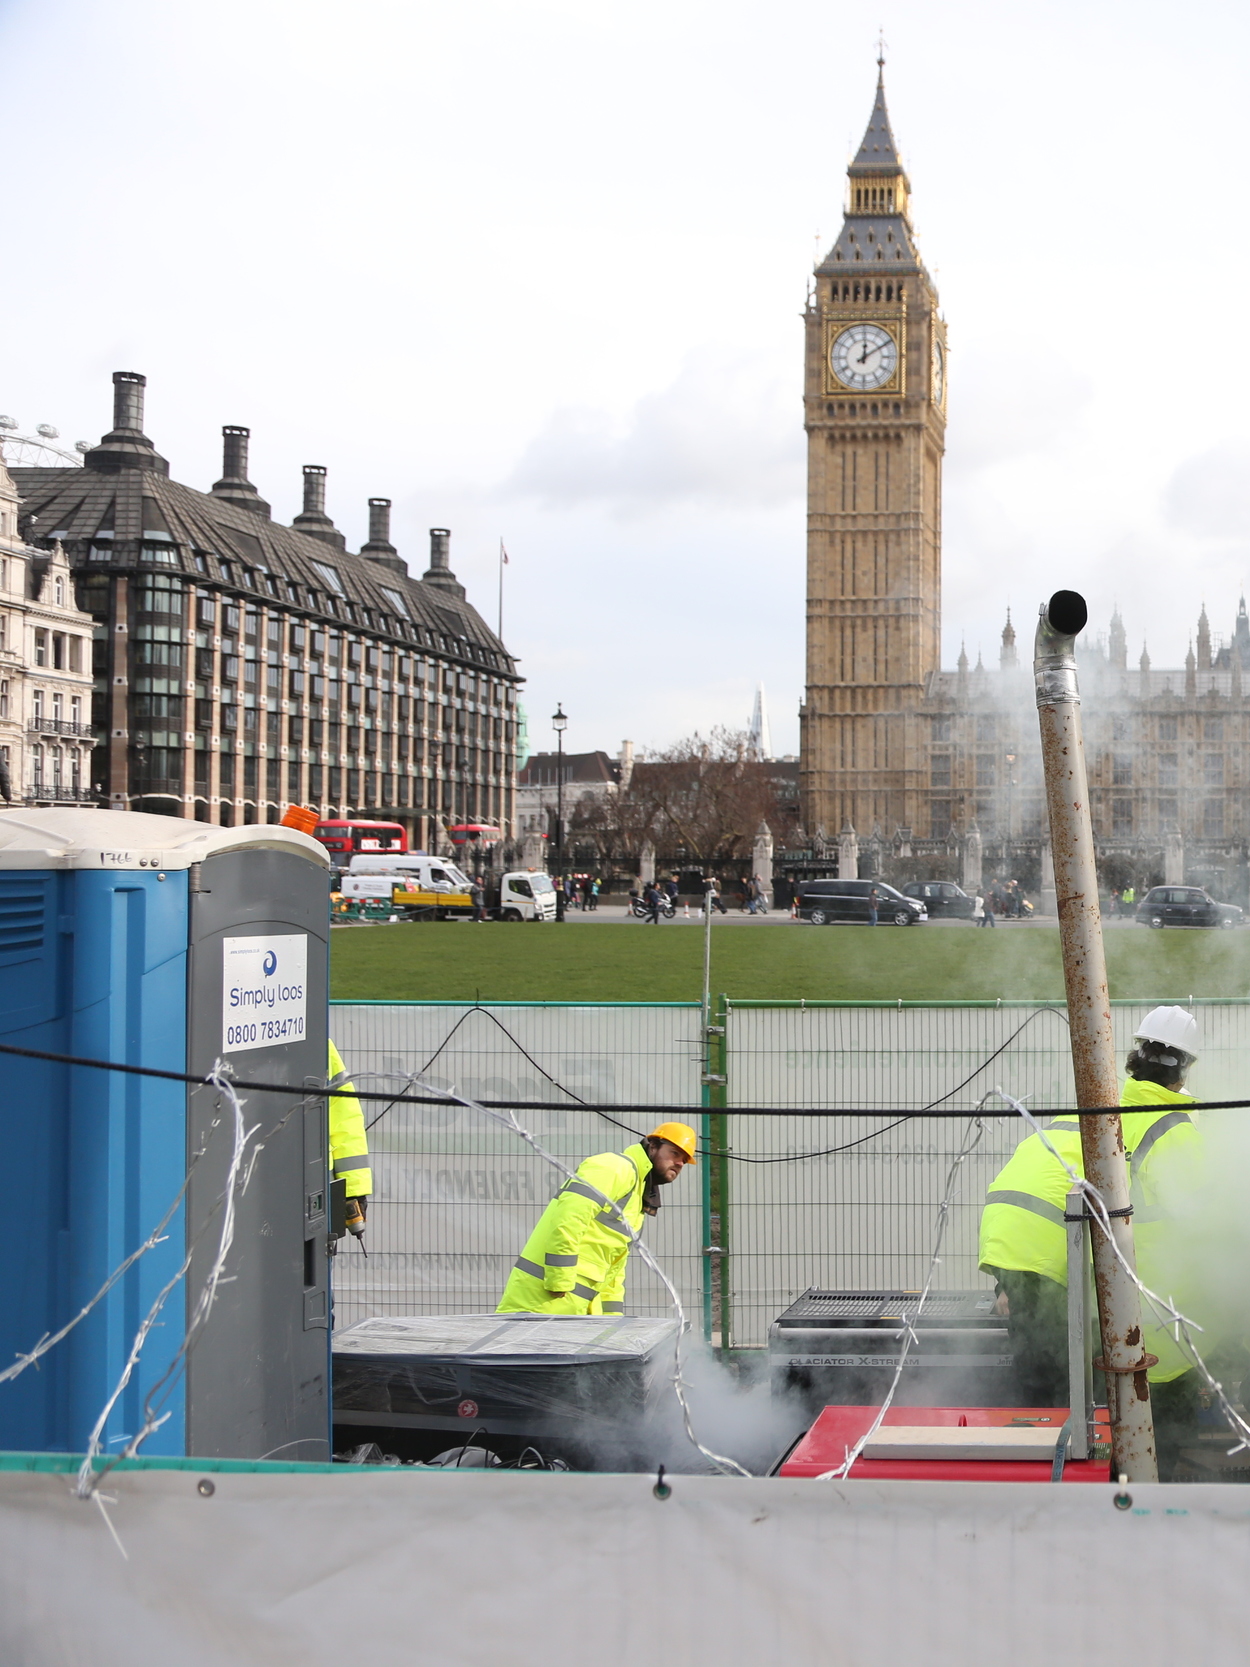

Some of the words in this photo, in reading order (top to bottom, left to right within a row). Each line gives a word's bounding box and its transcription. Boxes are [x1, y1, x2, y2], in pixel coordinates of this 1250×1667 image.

[230, 984, 275, 1009] Simply
[278, 983, 303, 1002] loos
[227, 1023, 257, 1045] 0800
[261, 1016, 304, 1040] 7834710
